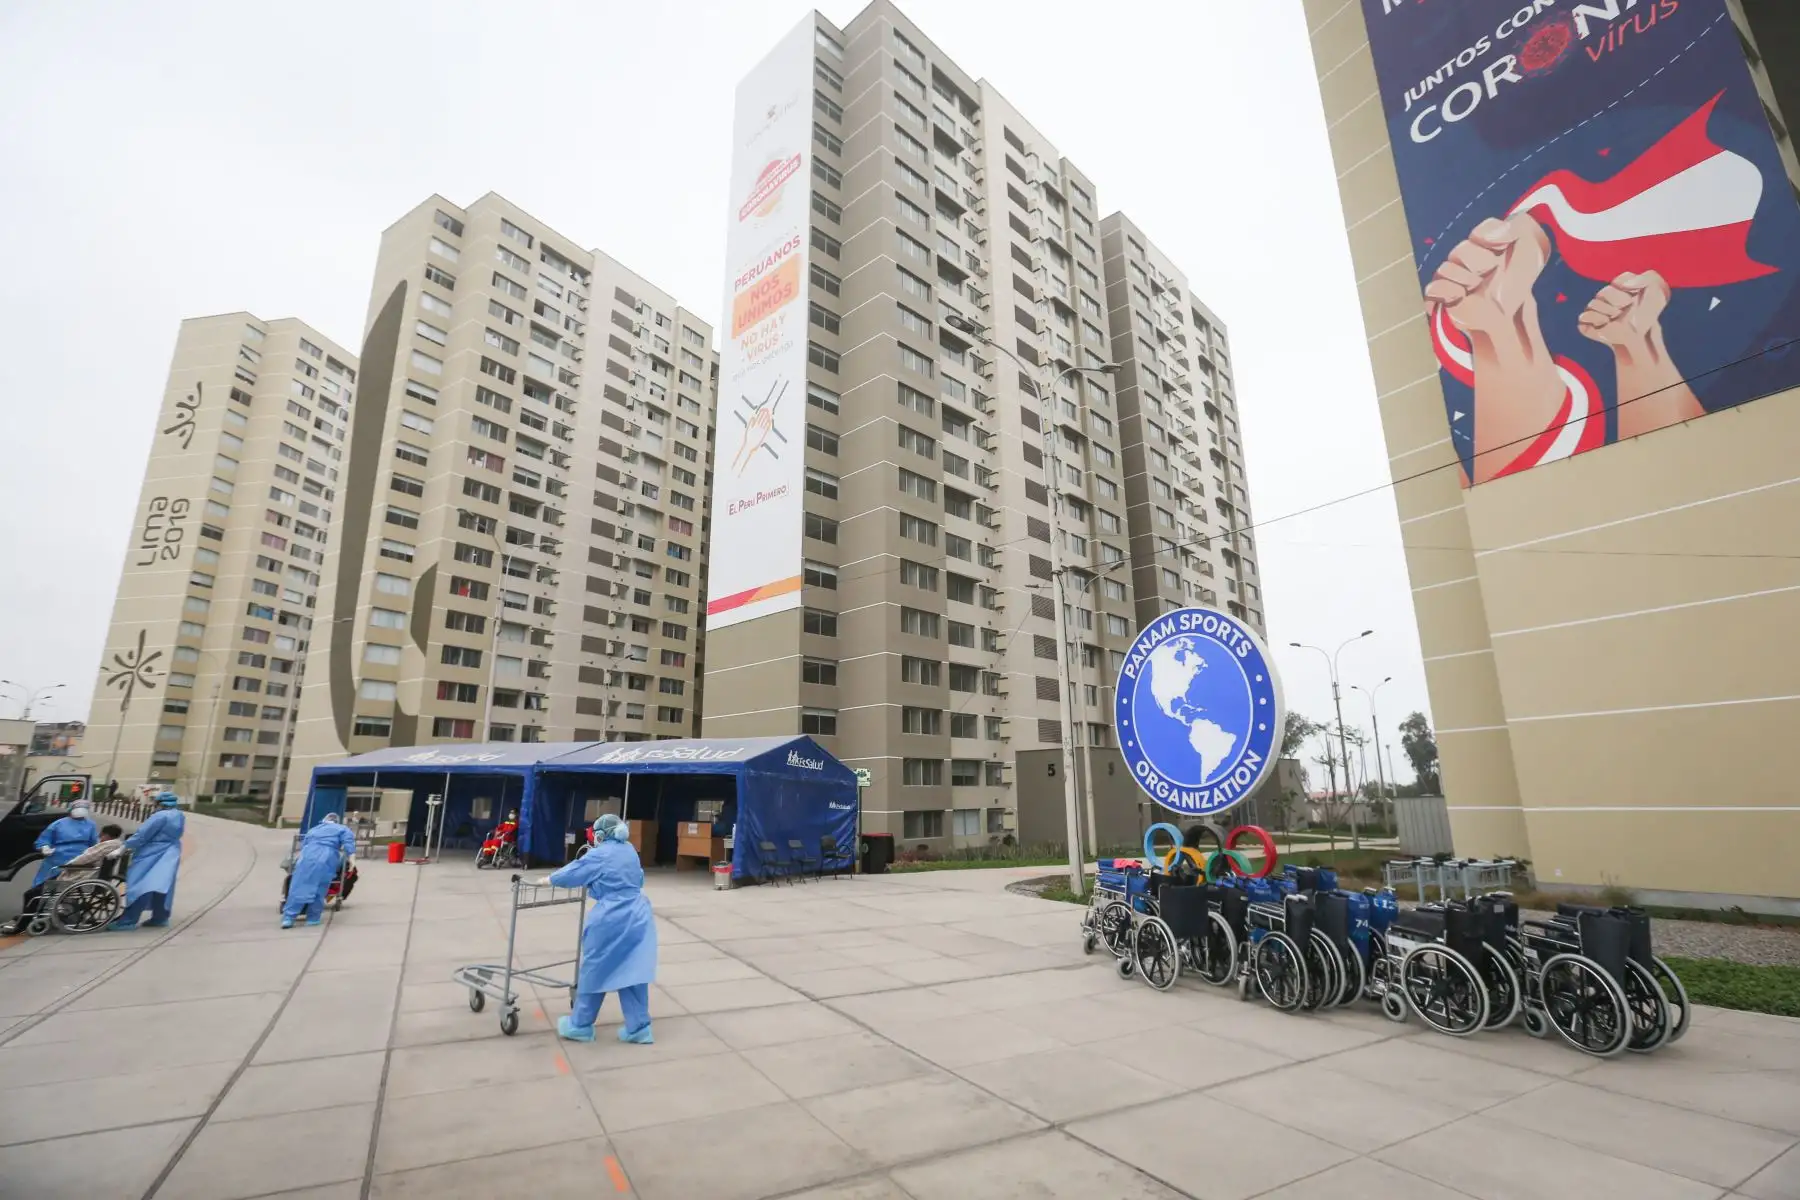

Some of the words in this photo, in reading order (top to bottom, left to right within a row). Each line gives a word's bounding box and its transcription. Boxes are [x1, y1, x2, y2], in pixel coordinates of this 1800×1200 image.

[1585, 0, 1679, 63] virus
[1404, 35, 1492, 111] JUNTOS
[734, 235, 800, 292] PERUANOS
[750, 274, 780, 304] NOS
[738, 282, 793, 329] UNIMOS
[741, 331, 758, 351] NO
[761, 312, 786, 338] HAY
[161, 498, 190, 560] 2019
[1124, 618, 1176, 680] PANAM
[1179, 613, 1251, 658] SPORTS
[1047, 763, 1056, 777] 5
[1136, 749, 1262, 809] ORGANIZATION
[1355, 919, 1369, 928] 74
